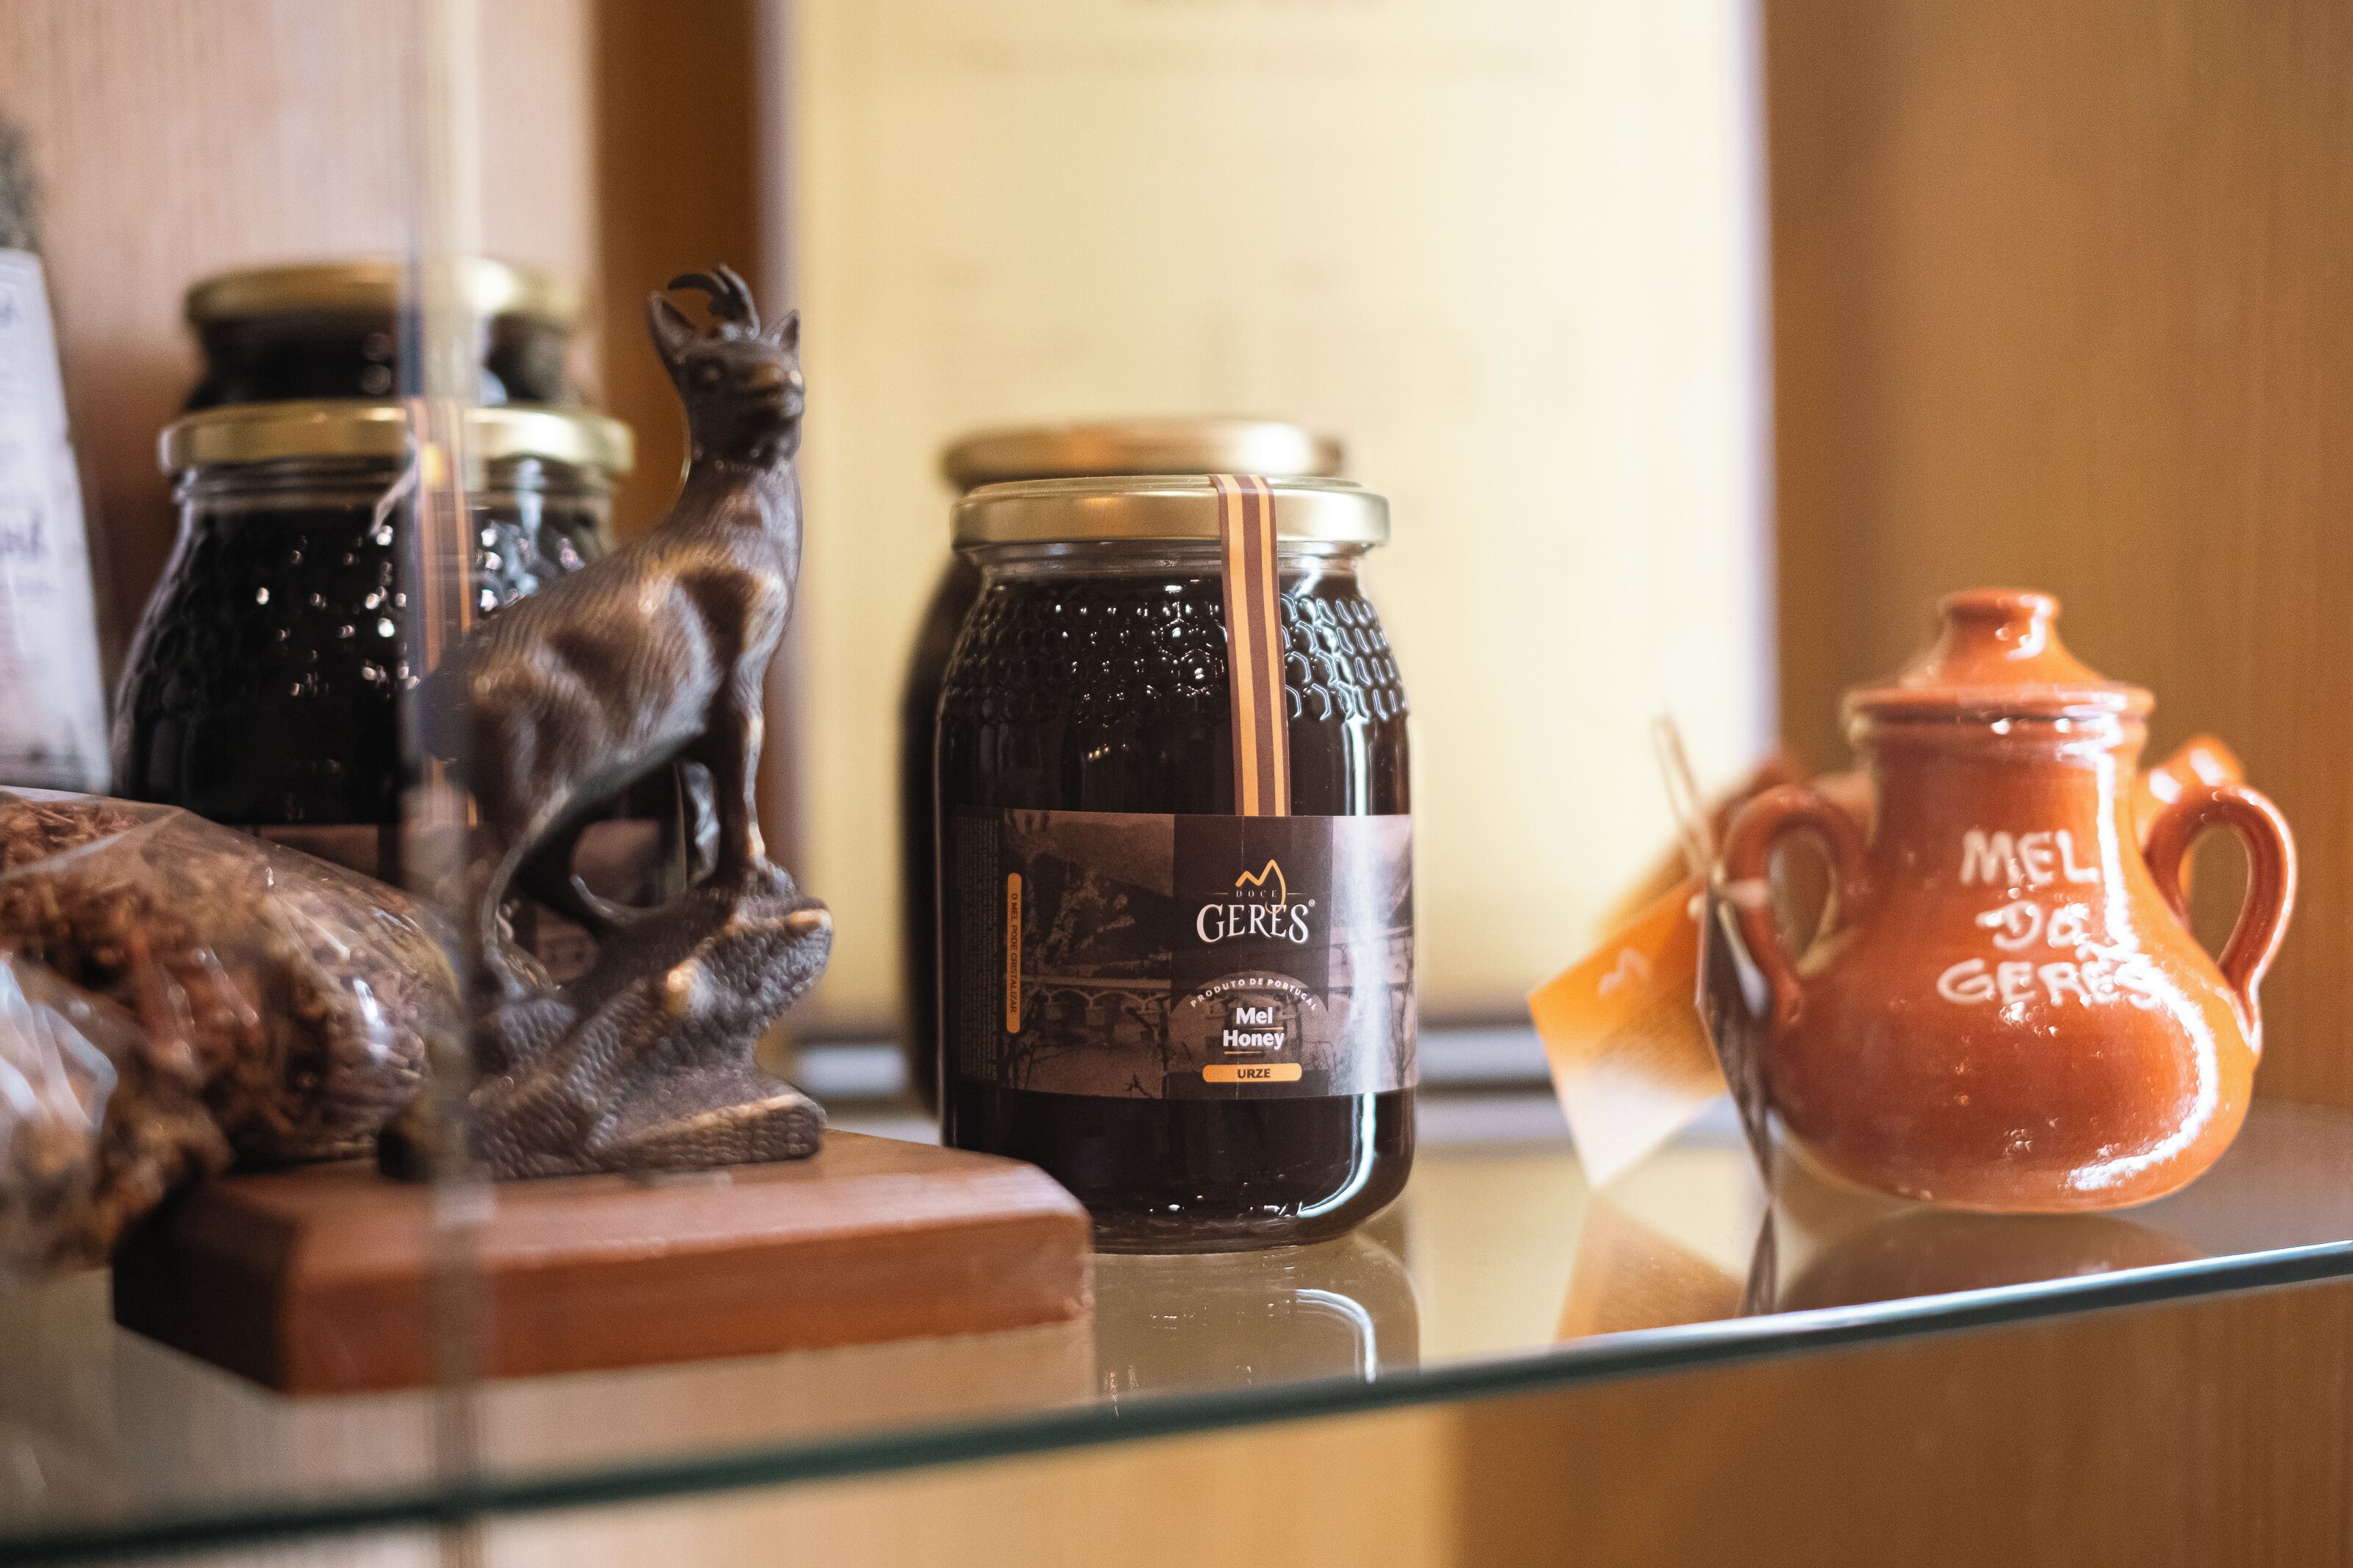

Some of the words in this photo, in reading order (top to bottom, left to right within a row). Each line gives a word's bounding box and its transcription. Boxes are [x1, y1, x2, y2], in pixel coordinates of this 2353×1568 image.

[1960, 830, 2099, 884] MEL
[1235, 889, 1278, 898] DOCE
[1010, 924, 1018, 951] PODE
[1010, 952, 1018, 1014] CRISTALIZAR
[1190, 978, 1246, 1008] PRODUTO
[1249, 978, 1264, 986] DE
[1267, 978, 1318, 1012] PORTUGAL
[1235, 1006, 1274, 1025] Mel
[1223, 1029, 1285, 1050] Honey
[1237, 1068, 1271, 1079] URZE
